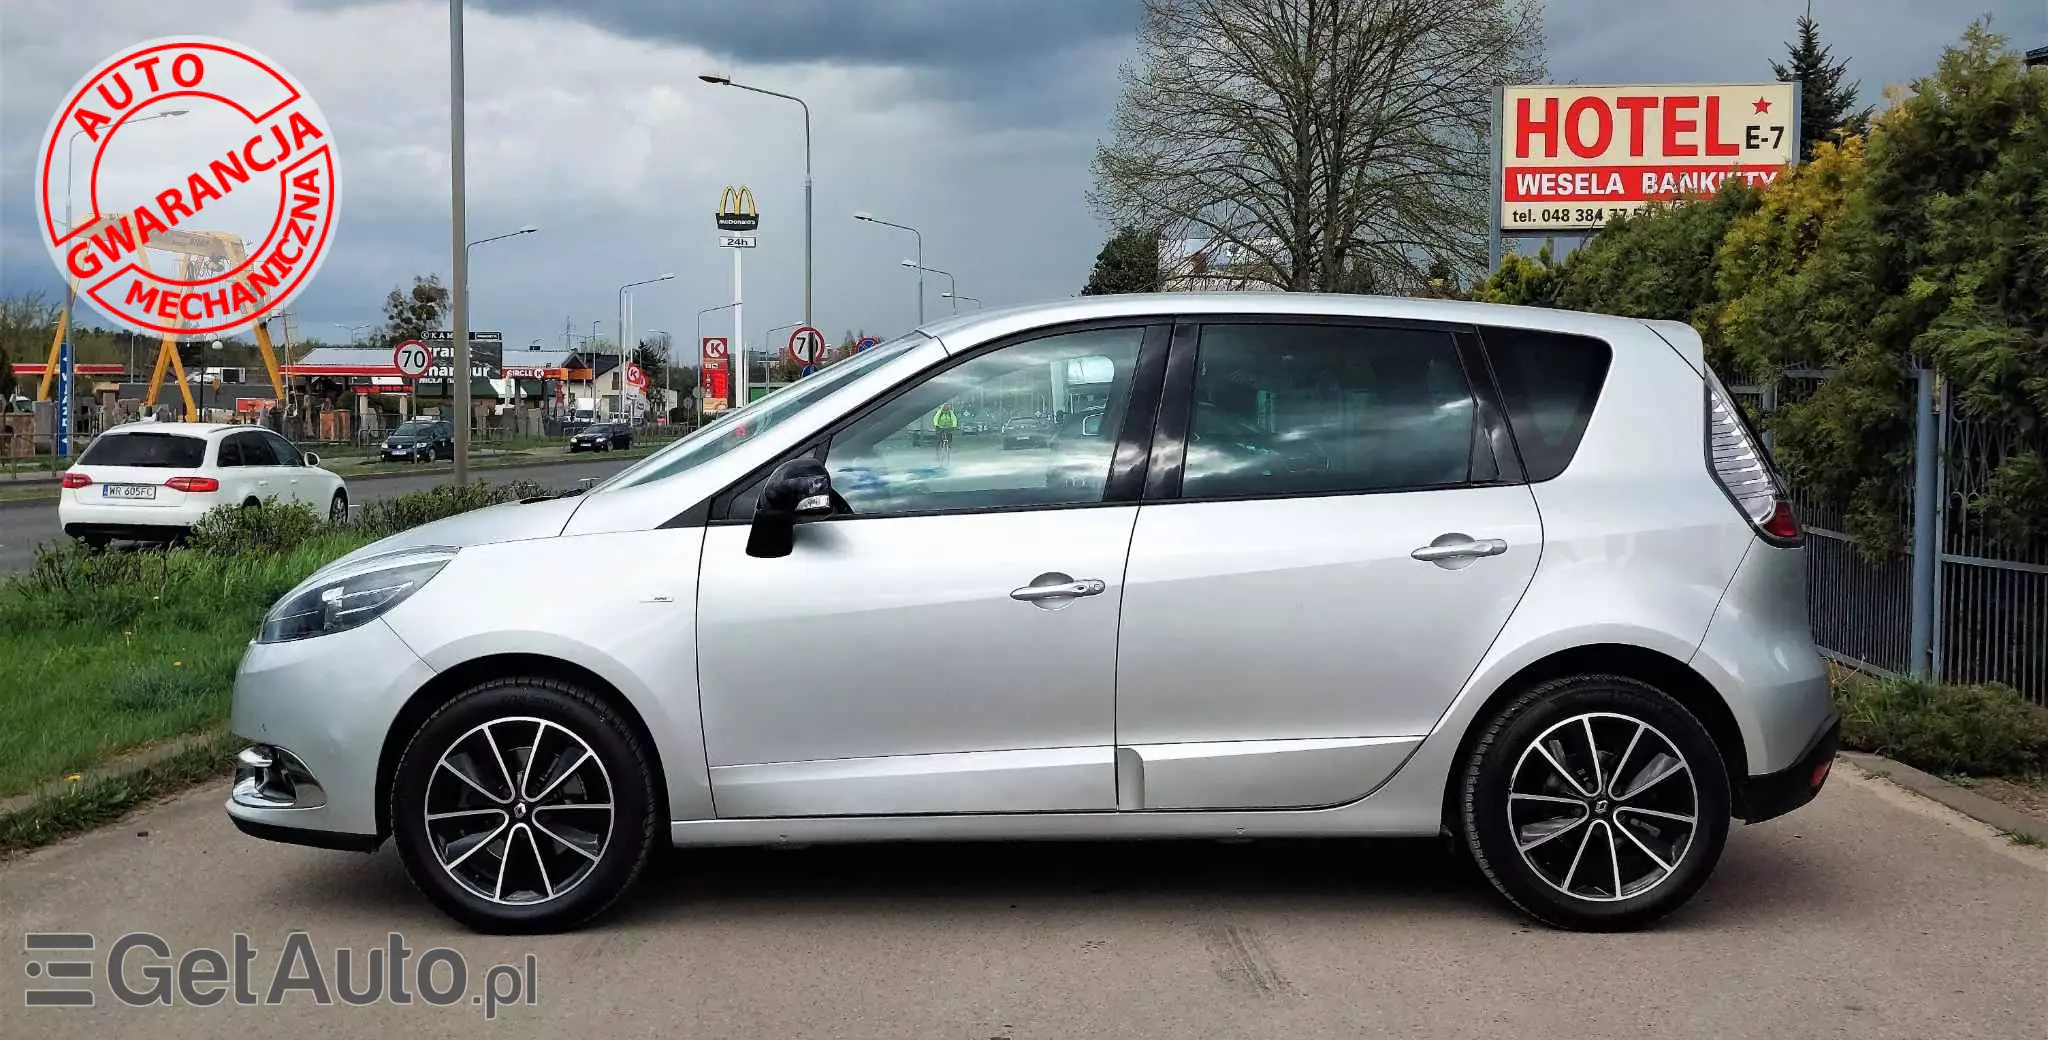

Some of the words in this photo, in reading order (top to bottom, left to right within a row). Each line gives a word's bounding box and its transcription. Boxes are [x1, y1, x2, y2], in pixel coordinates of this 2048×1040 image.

[1515, 95, 1740, 159] HOTEL
[1744, 125, 1785, 149] E-7
[1516, 172, 1625, 195] WESELA
[1512, 208, 1537, 222] tel.
[1541, 208, 1570, 222] 048
[1575, 208, 1604, 222] 384
[727, 238, 748, 246] 24h
[402, 350, 425, 368] 70
